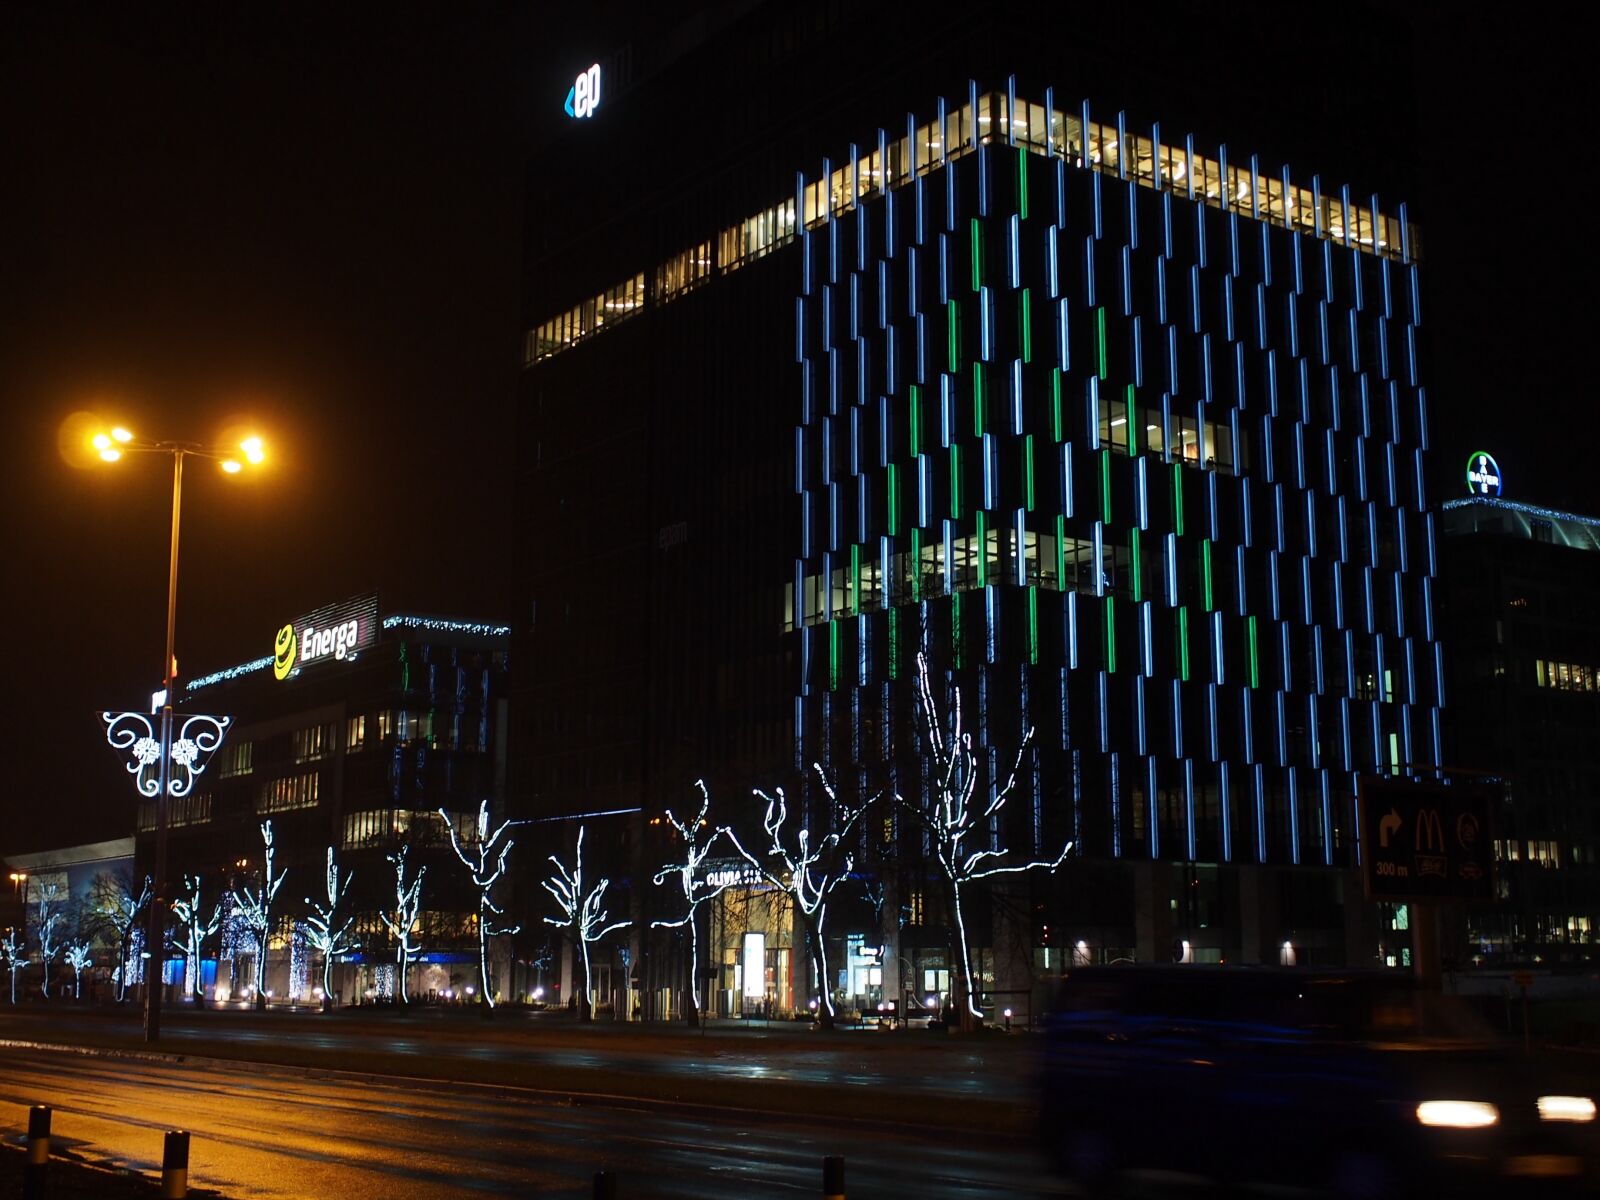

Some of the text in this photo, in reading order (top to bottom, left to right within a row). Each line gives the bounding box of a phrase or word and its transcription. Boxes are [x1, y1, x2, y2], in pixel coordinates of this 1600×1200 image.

[301, 620, 359, 661] Energa
[1375, 860, 1396, 876] 300
[1397, 864, 1409, 877] m
